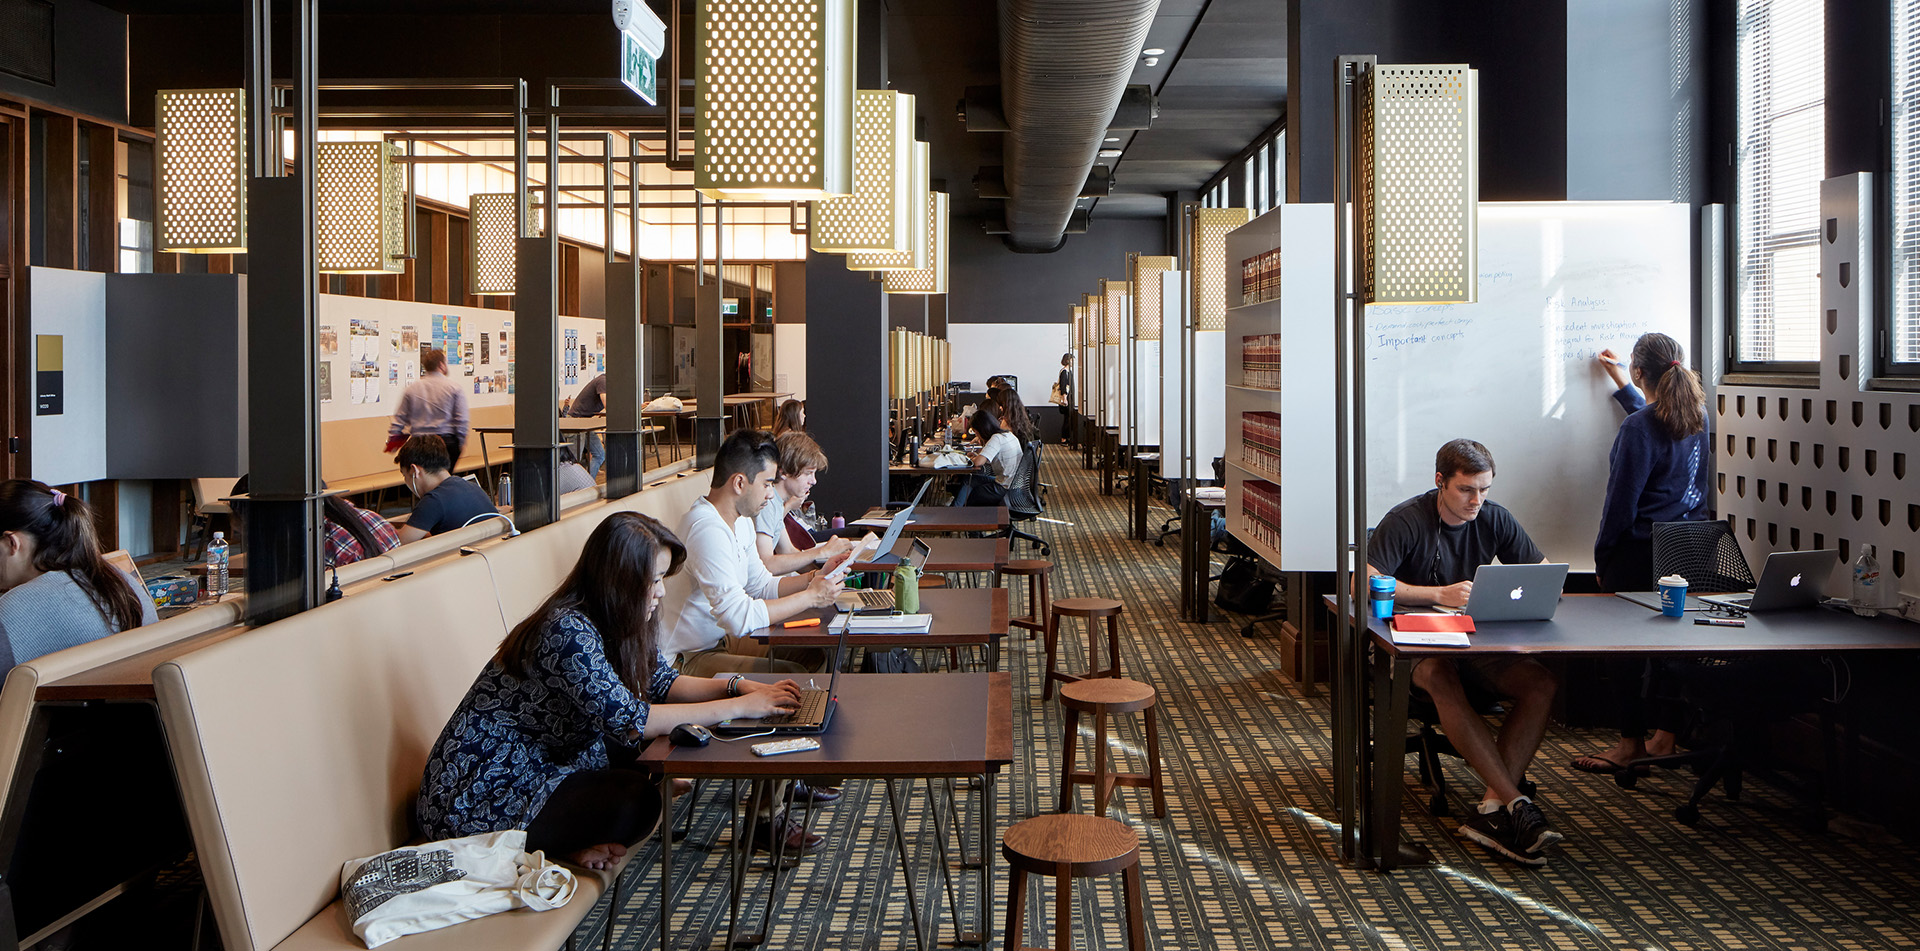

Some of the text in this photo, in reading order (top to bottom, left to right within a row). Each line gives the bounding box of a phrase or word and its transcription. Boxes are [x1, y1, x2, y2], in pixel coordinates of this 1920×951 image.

[1571, 296, 1607, 310] Analysis
[1378, 329, 1465, 350] Important concepts
[1600, 332, 1615, 341] Risk
[1577, 348, 1584, 361] of
